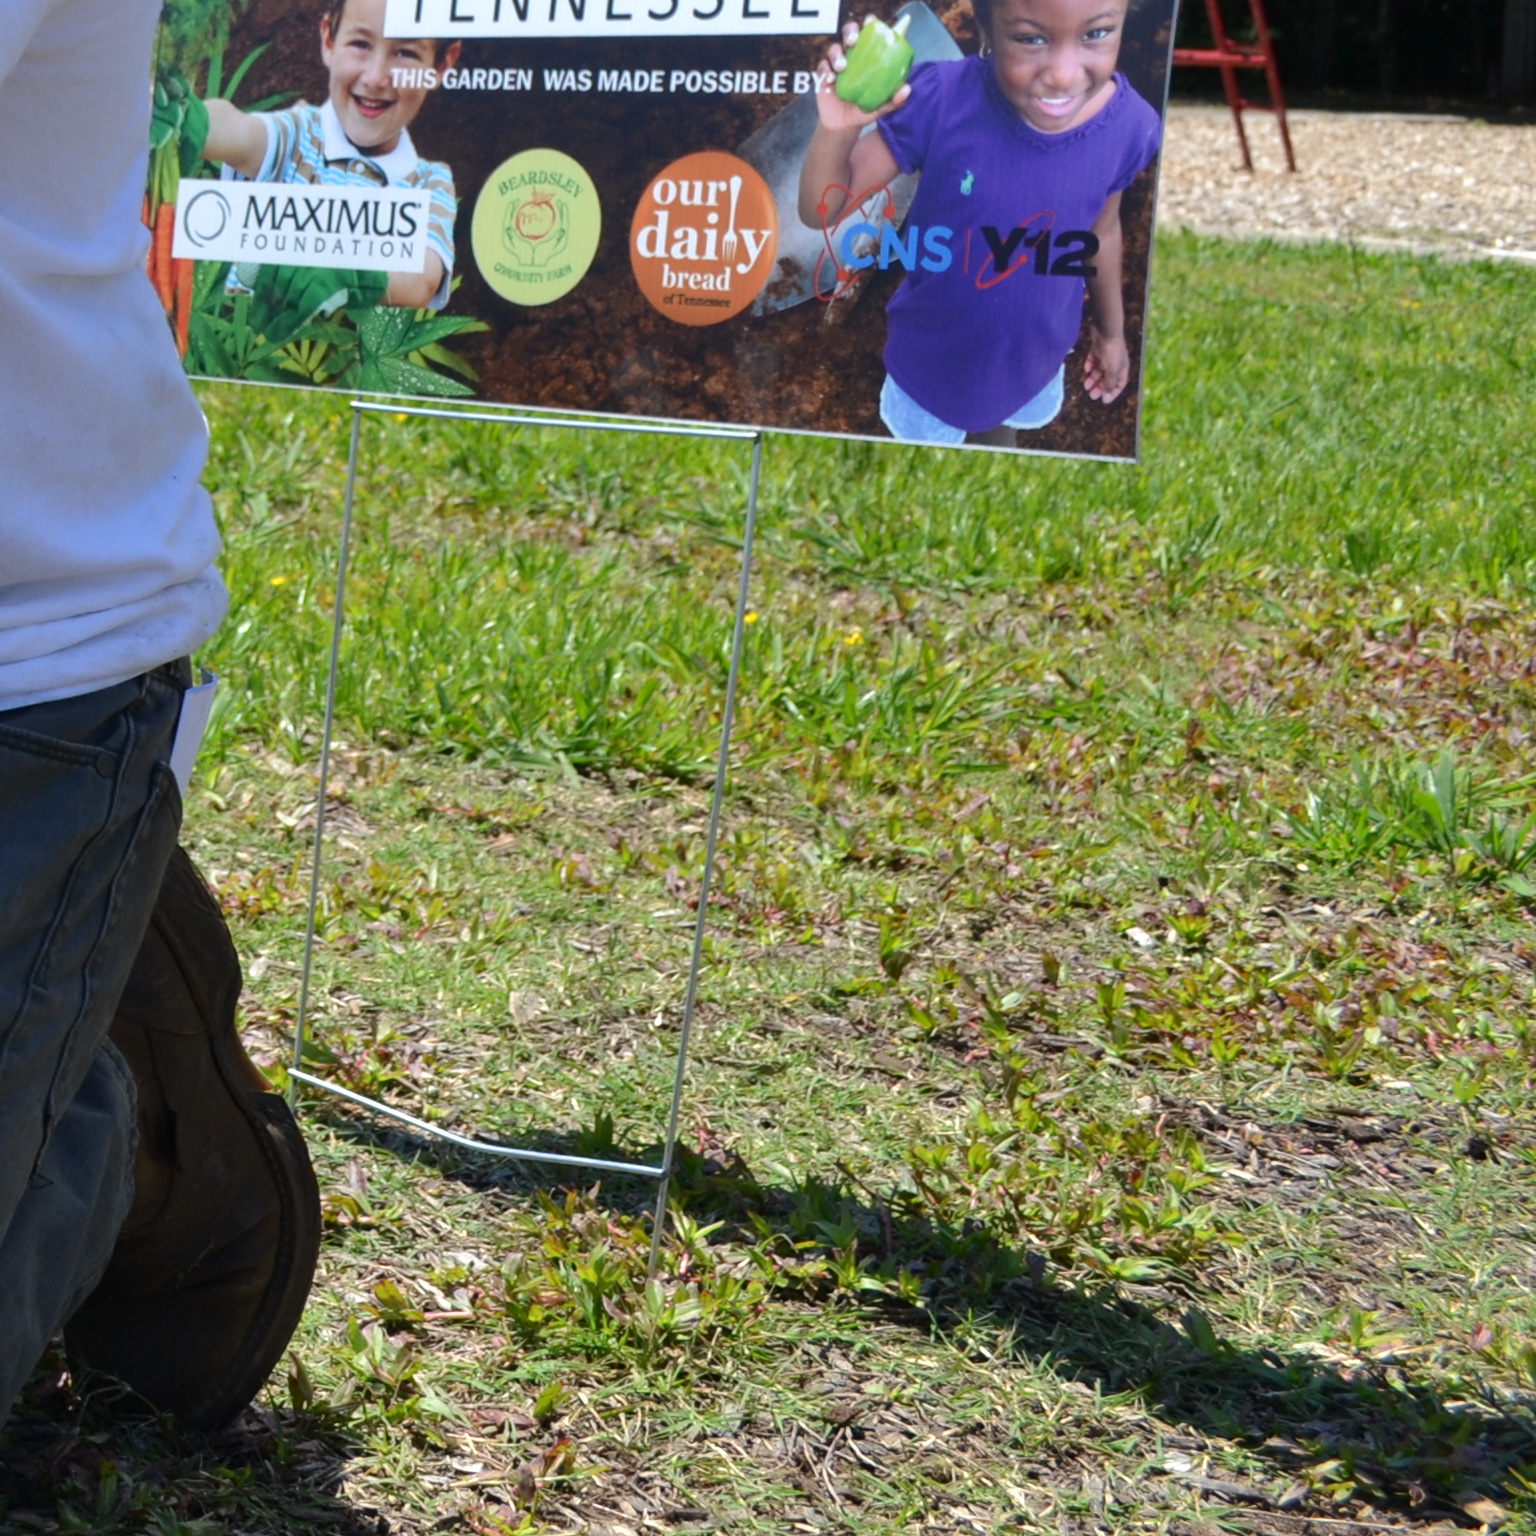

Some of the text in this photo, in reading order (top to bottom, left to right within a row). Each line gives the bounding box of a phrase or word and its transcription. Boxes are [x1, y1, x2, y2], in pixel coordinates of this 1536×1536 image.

[390, 67, 834, 95] THIS GARDEN WAS MADE POSSIBLE BY:
[497, 170, 584, 199] BEARDSLEY
[652, 178, 728, 207] our
[636, 175, 773, 275] daily
[240, 233, 414, 259] FOUNDATION
[840, 222, 1101, 278] CNS Y12
[546, 264, 573, 283] FARM
[662, 263, 732, 292] bread
[663, 293, 732, 309] of Tennessee
